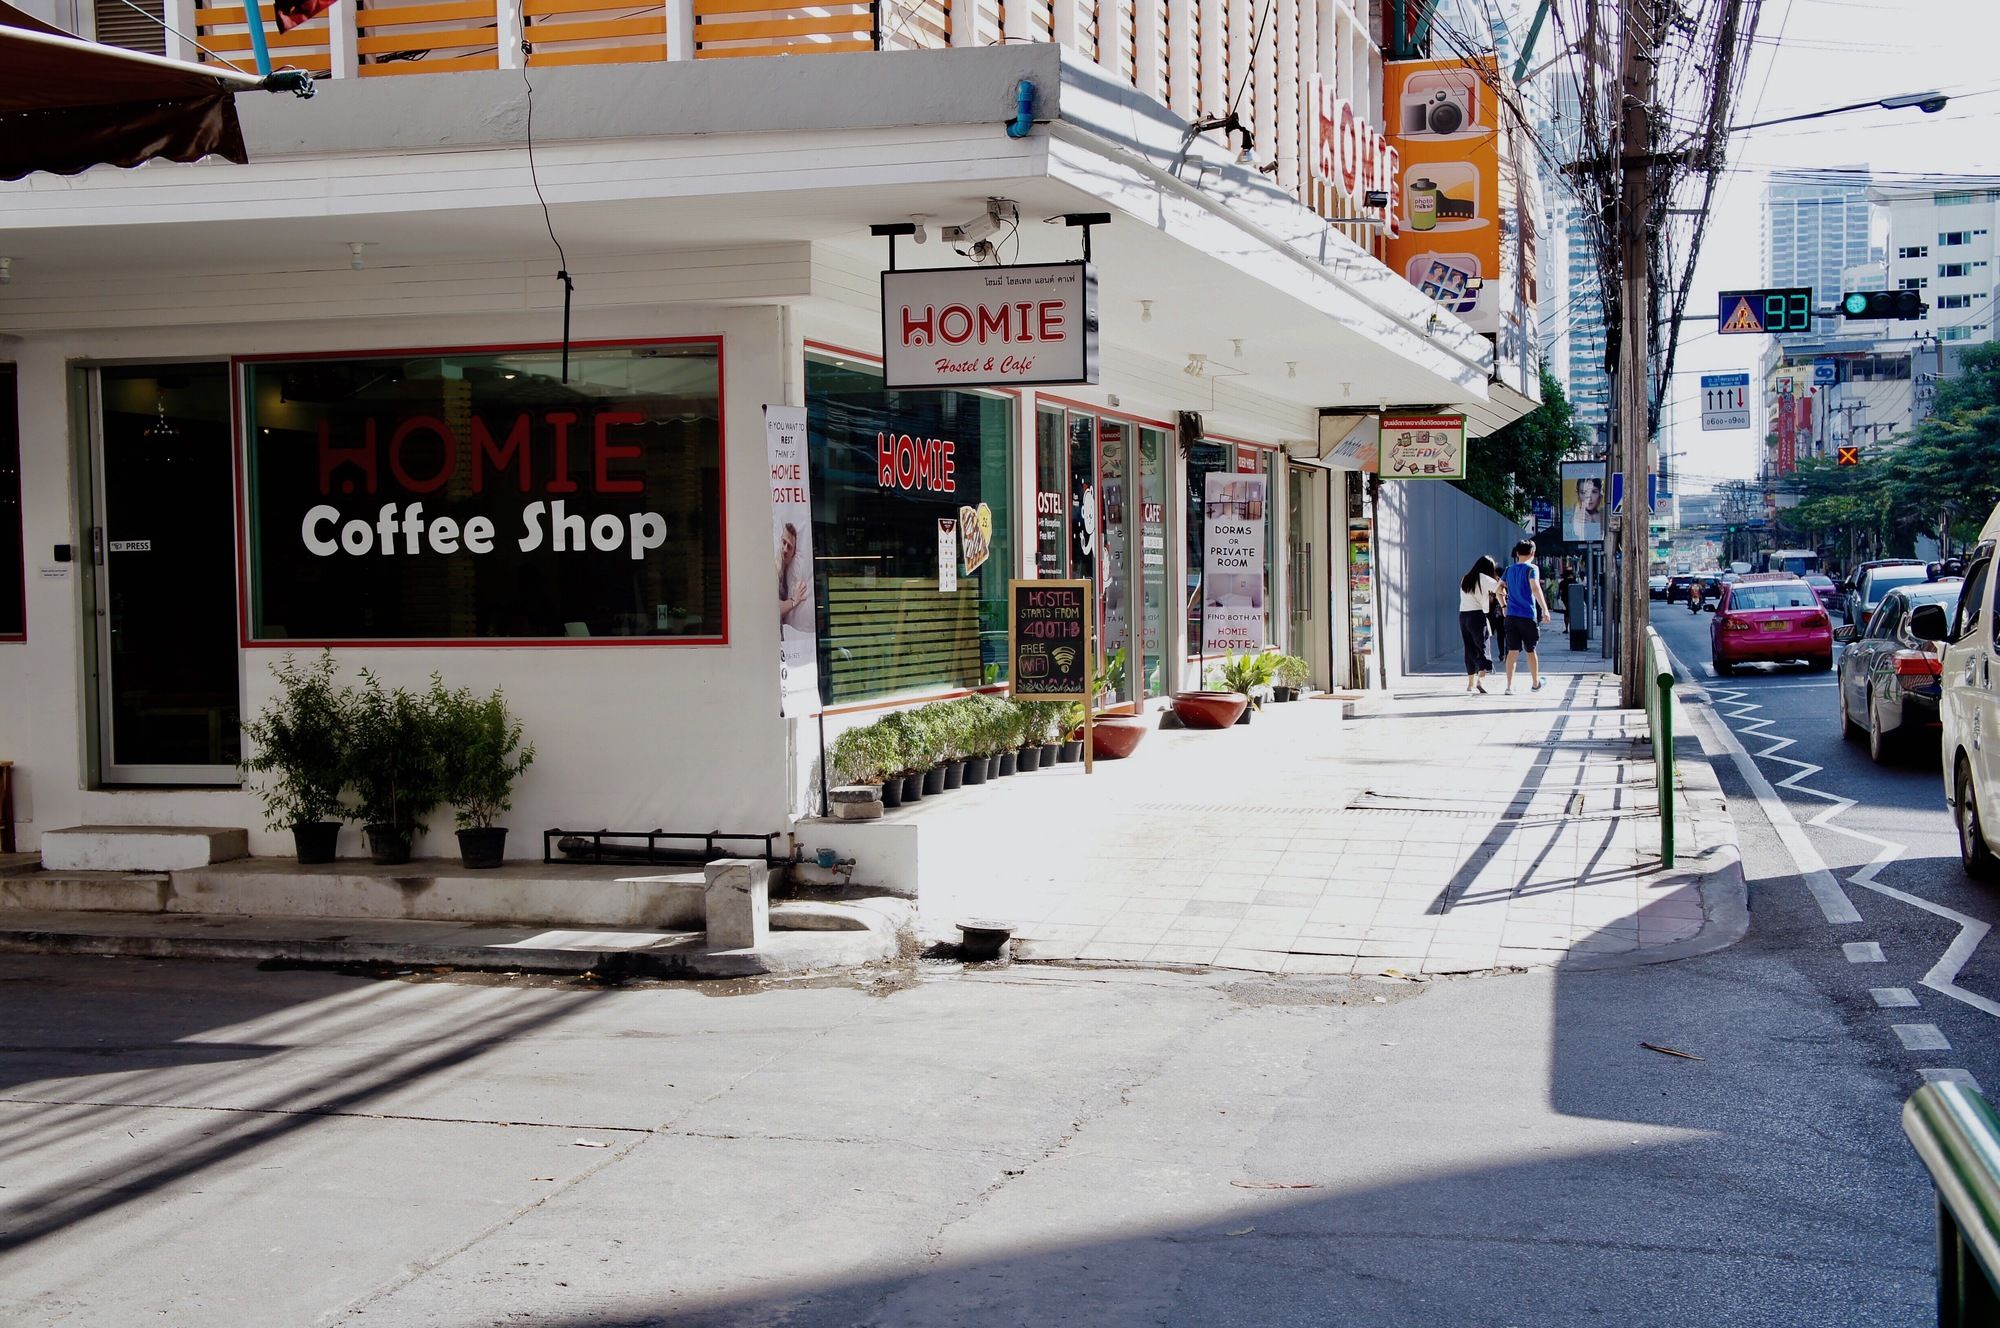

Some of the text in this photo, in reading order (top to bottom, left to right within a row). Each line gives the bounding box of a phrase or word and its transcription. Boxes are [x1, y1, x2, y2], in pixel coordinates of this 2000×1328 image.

[1765, 294, 1808, 330] 93
[901, 299, 1066, 347] HOMIE
[935, 358, 979, 374] Hostel
[983, 356, 995, 371] &
[773, 422, 785, 430] YOU
[785, 422, 798, 431] WANT
[781, 436, 793, 444] REST
[318, 411, 646, 496] HOMIE
[877, 432, 955, 493] HOMIE
[771, 465, 800, 480] HOMIE
[1037, 491, 1062, 514] OSTEL
[302, 499, 667, 560] Coffee Shop
[1215, 525, 1252, 535] DORMS
[126, 542, 149, 550] PRESS
[1210, 546, 1255, 557] PRIVATE
[1217, 558, 1248, 567] ROOM
[1029, 591, 1080, 607] HOSTEL
[1021, 607, 1080, 619] STARTS FROM
[1217, 628, 1247, 636] HOMIE
[1020, 643, 1046, 654] FREE
[1207, 639, 1259, 649] HOSTEL
